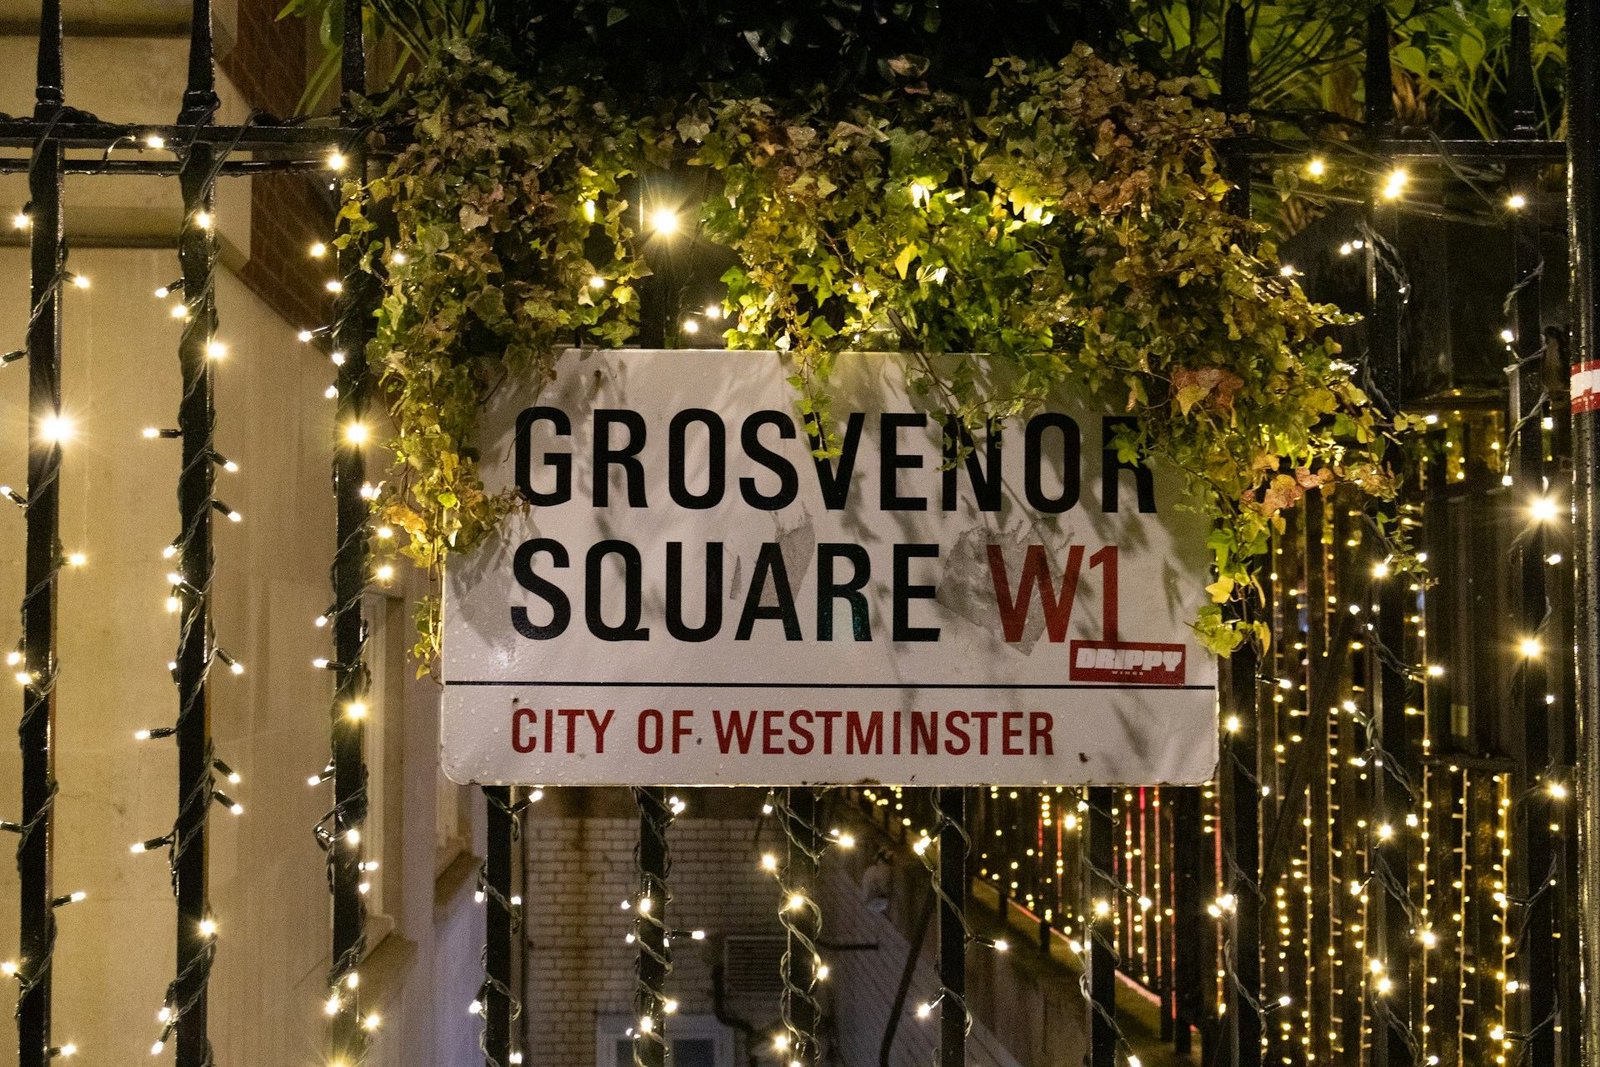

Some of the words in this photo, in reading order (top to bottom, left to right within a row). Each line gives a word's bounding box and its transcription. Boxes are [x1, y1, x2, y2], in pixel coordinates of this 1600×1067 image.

[514, 406, 1157, 514] GROSVENOR
[511, 538, 941, 643] SQUARE
[986, 544, 1119, 643] W1
[1075, 647, 1183, 672] DRIPPY
[511, 708, 615, 753] CITY
[637, 709, 694, 754] OF
[712, 709, 1054, 755] WESTMINSTER
